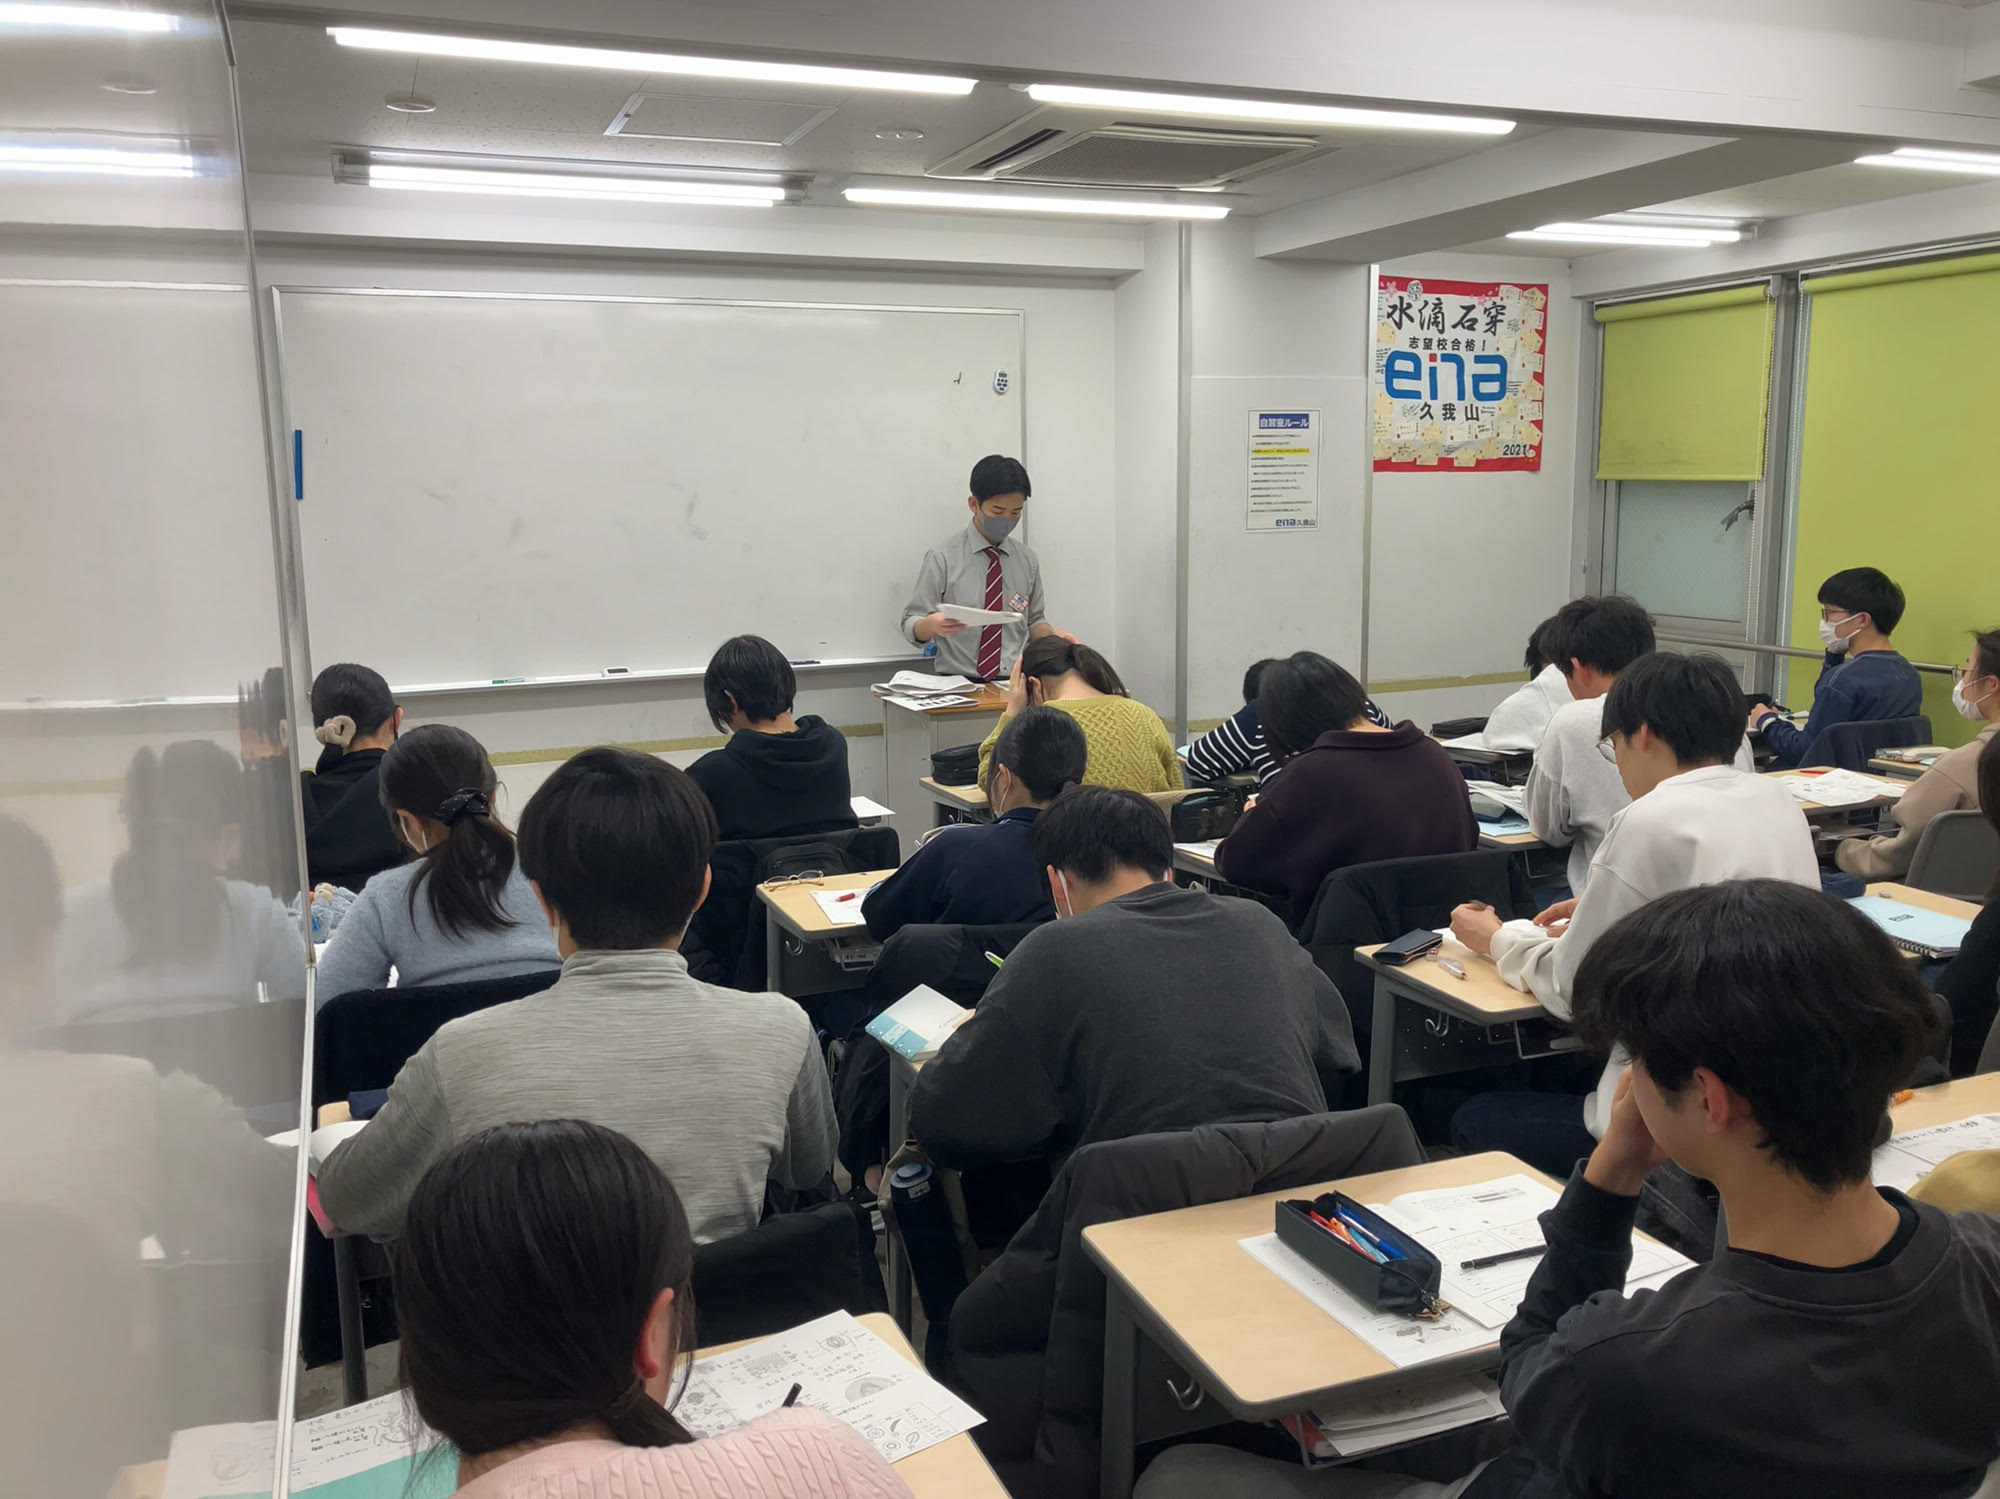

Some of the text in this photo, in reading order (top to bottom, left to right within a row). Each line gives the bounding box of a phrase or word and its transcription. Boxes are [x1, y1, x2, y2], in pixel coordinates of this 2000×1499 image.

[1386, 296, 1507, 336] 水滴石穿
[1384, 350, 1508, 401] ena
[1419, 402, 1480, 422] 久我山
